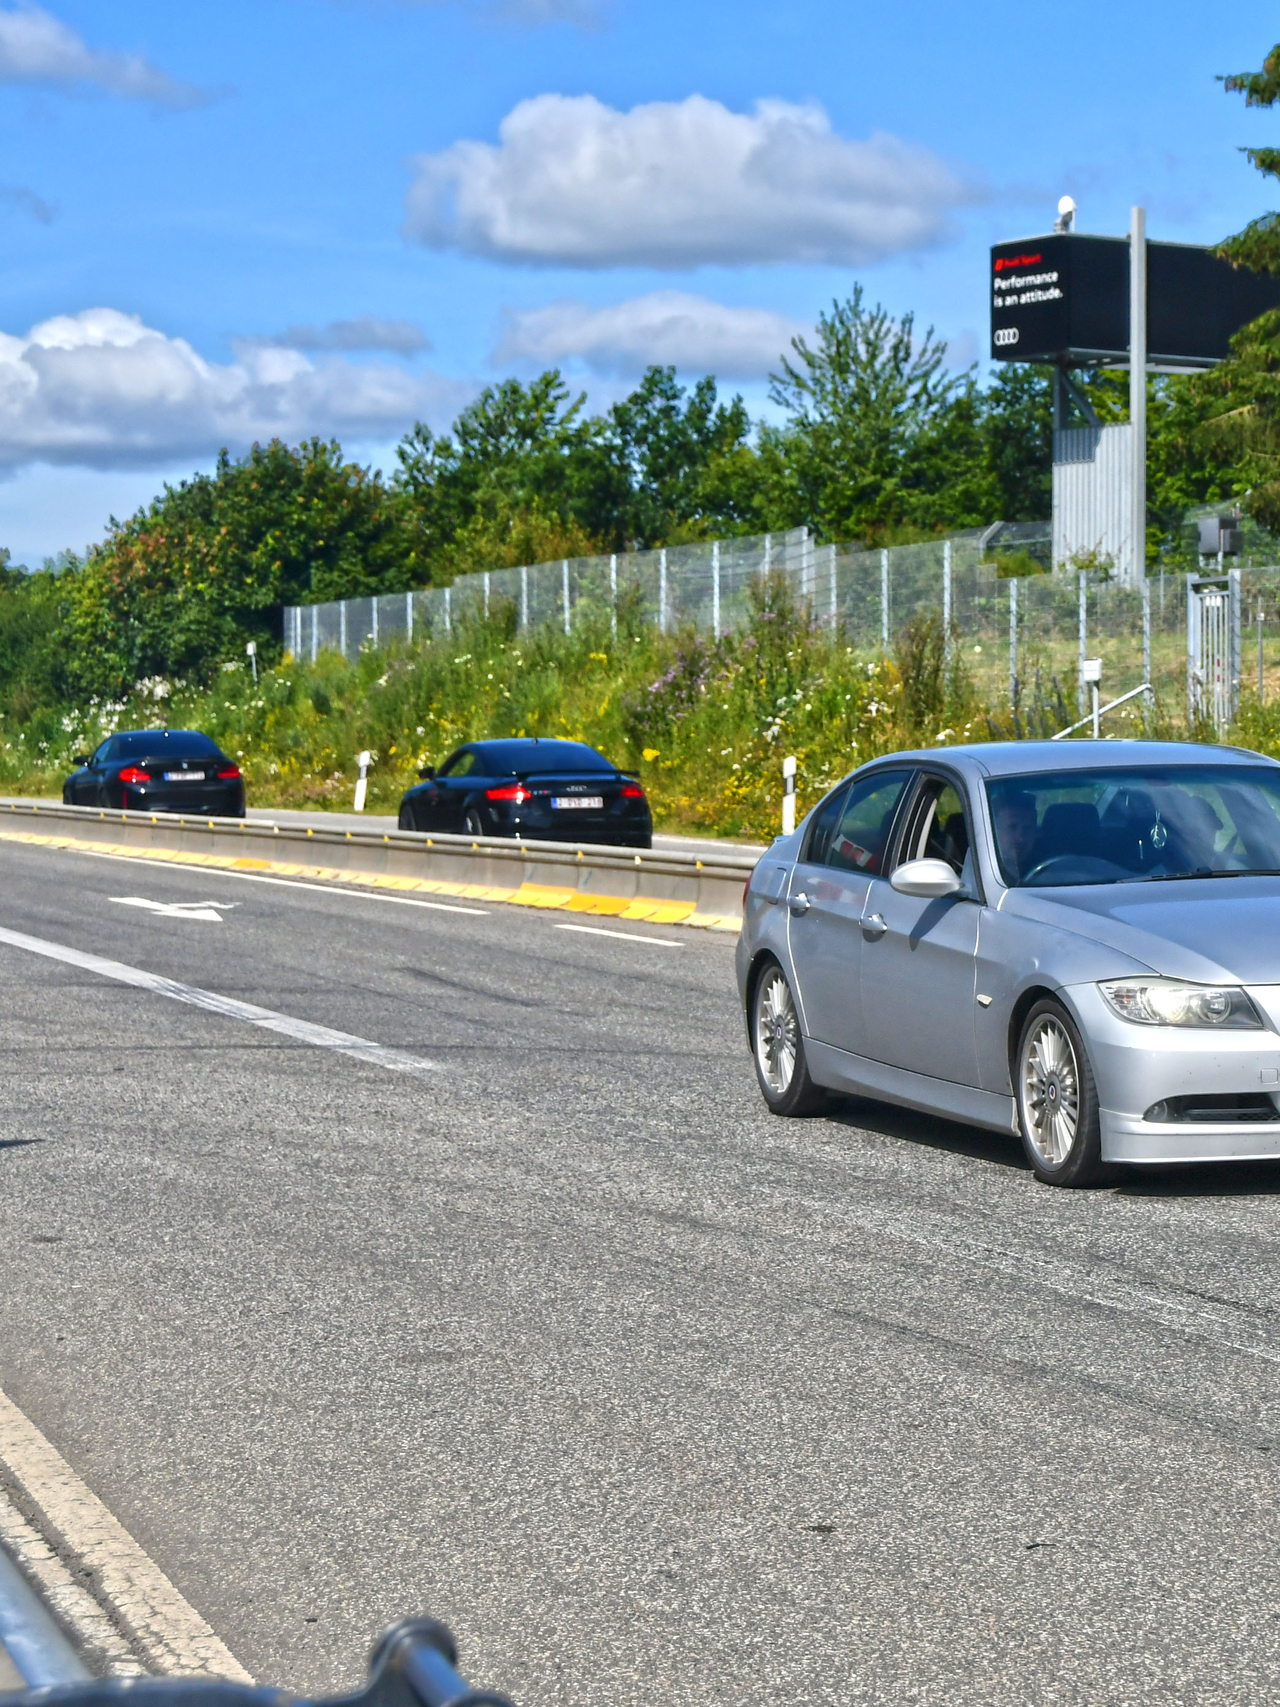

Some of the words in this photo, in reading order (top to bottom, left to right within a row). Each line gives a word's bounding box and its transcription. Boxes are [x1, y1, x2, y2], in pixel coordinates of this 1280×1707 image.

[994, 271, 1058, 291] Performance
[994, 294, 1003, 308] is
[1004, 294, 1019, 307] an
[1020, 286, 1063, 305] attitude.
